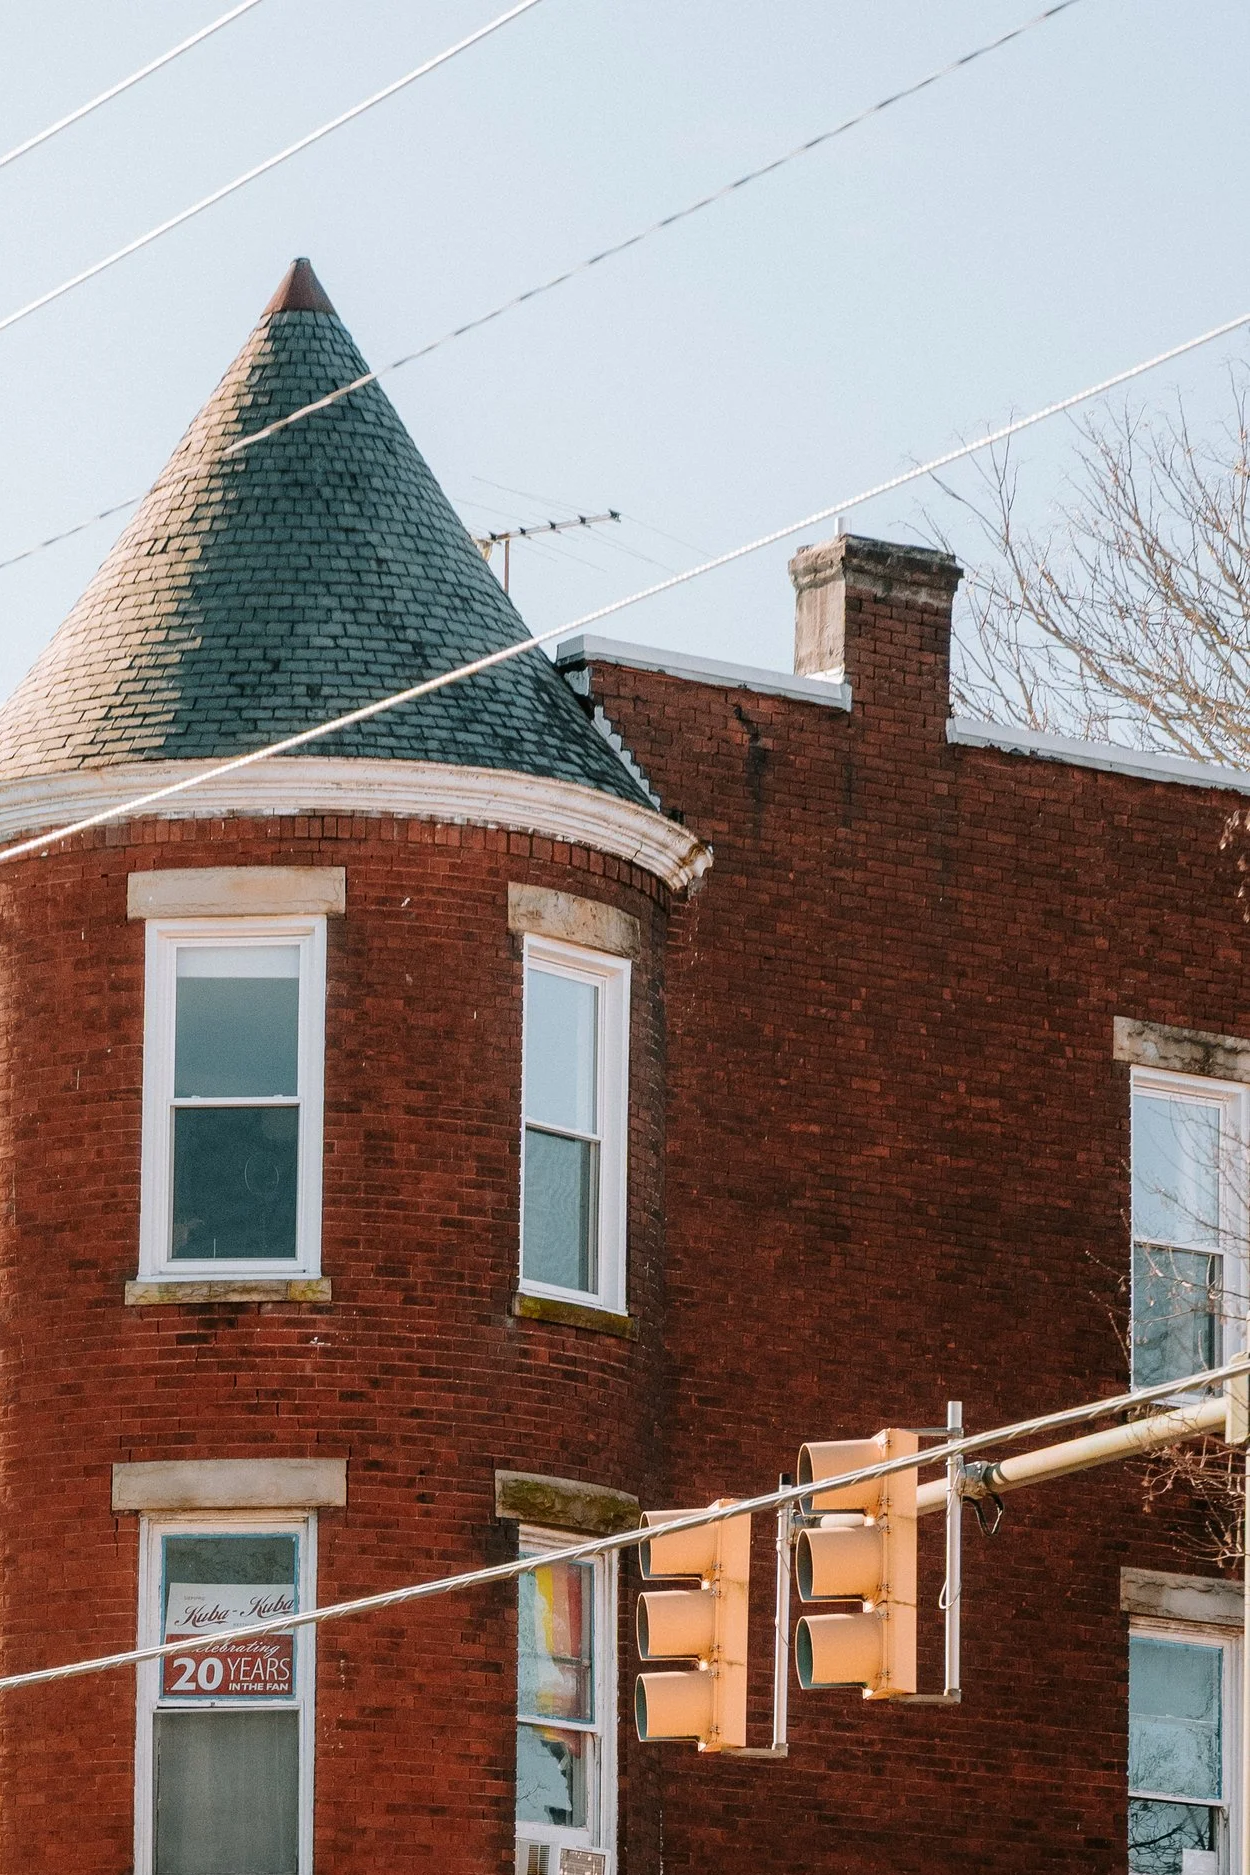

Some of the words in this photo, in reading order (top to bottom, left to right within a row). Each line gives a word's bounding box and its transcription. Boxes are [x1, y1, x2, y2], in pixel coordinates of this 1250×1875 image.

[174, 1604, 229, 1628] Kuba
[240, 1593, 295, 1619] Kuba
[170, 1657, 224, 1691] 20
[227, 1657, 290, 1681] YEARS
[241, 1682, 264, 1691] THE
[266, 1682, 289, 1691] FAN
